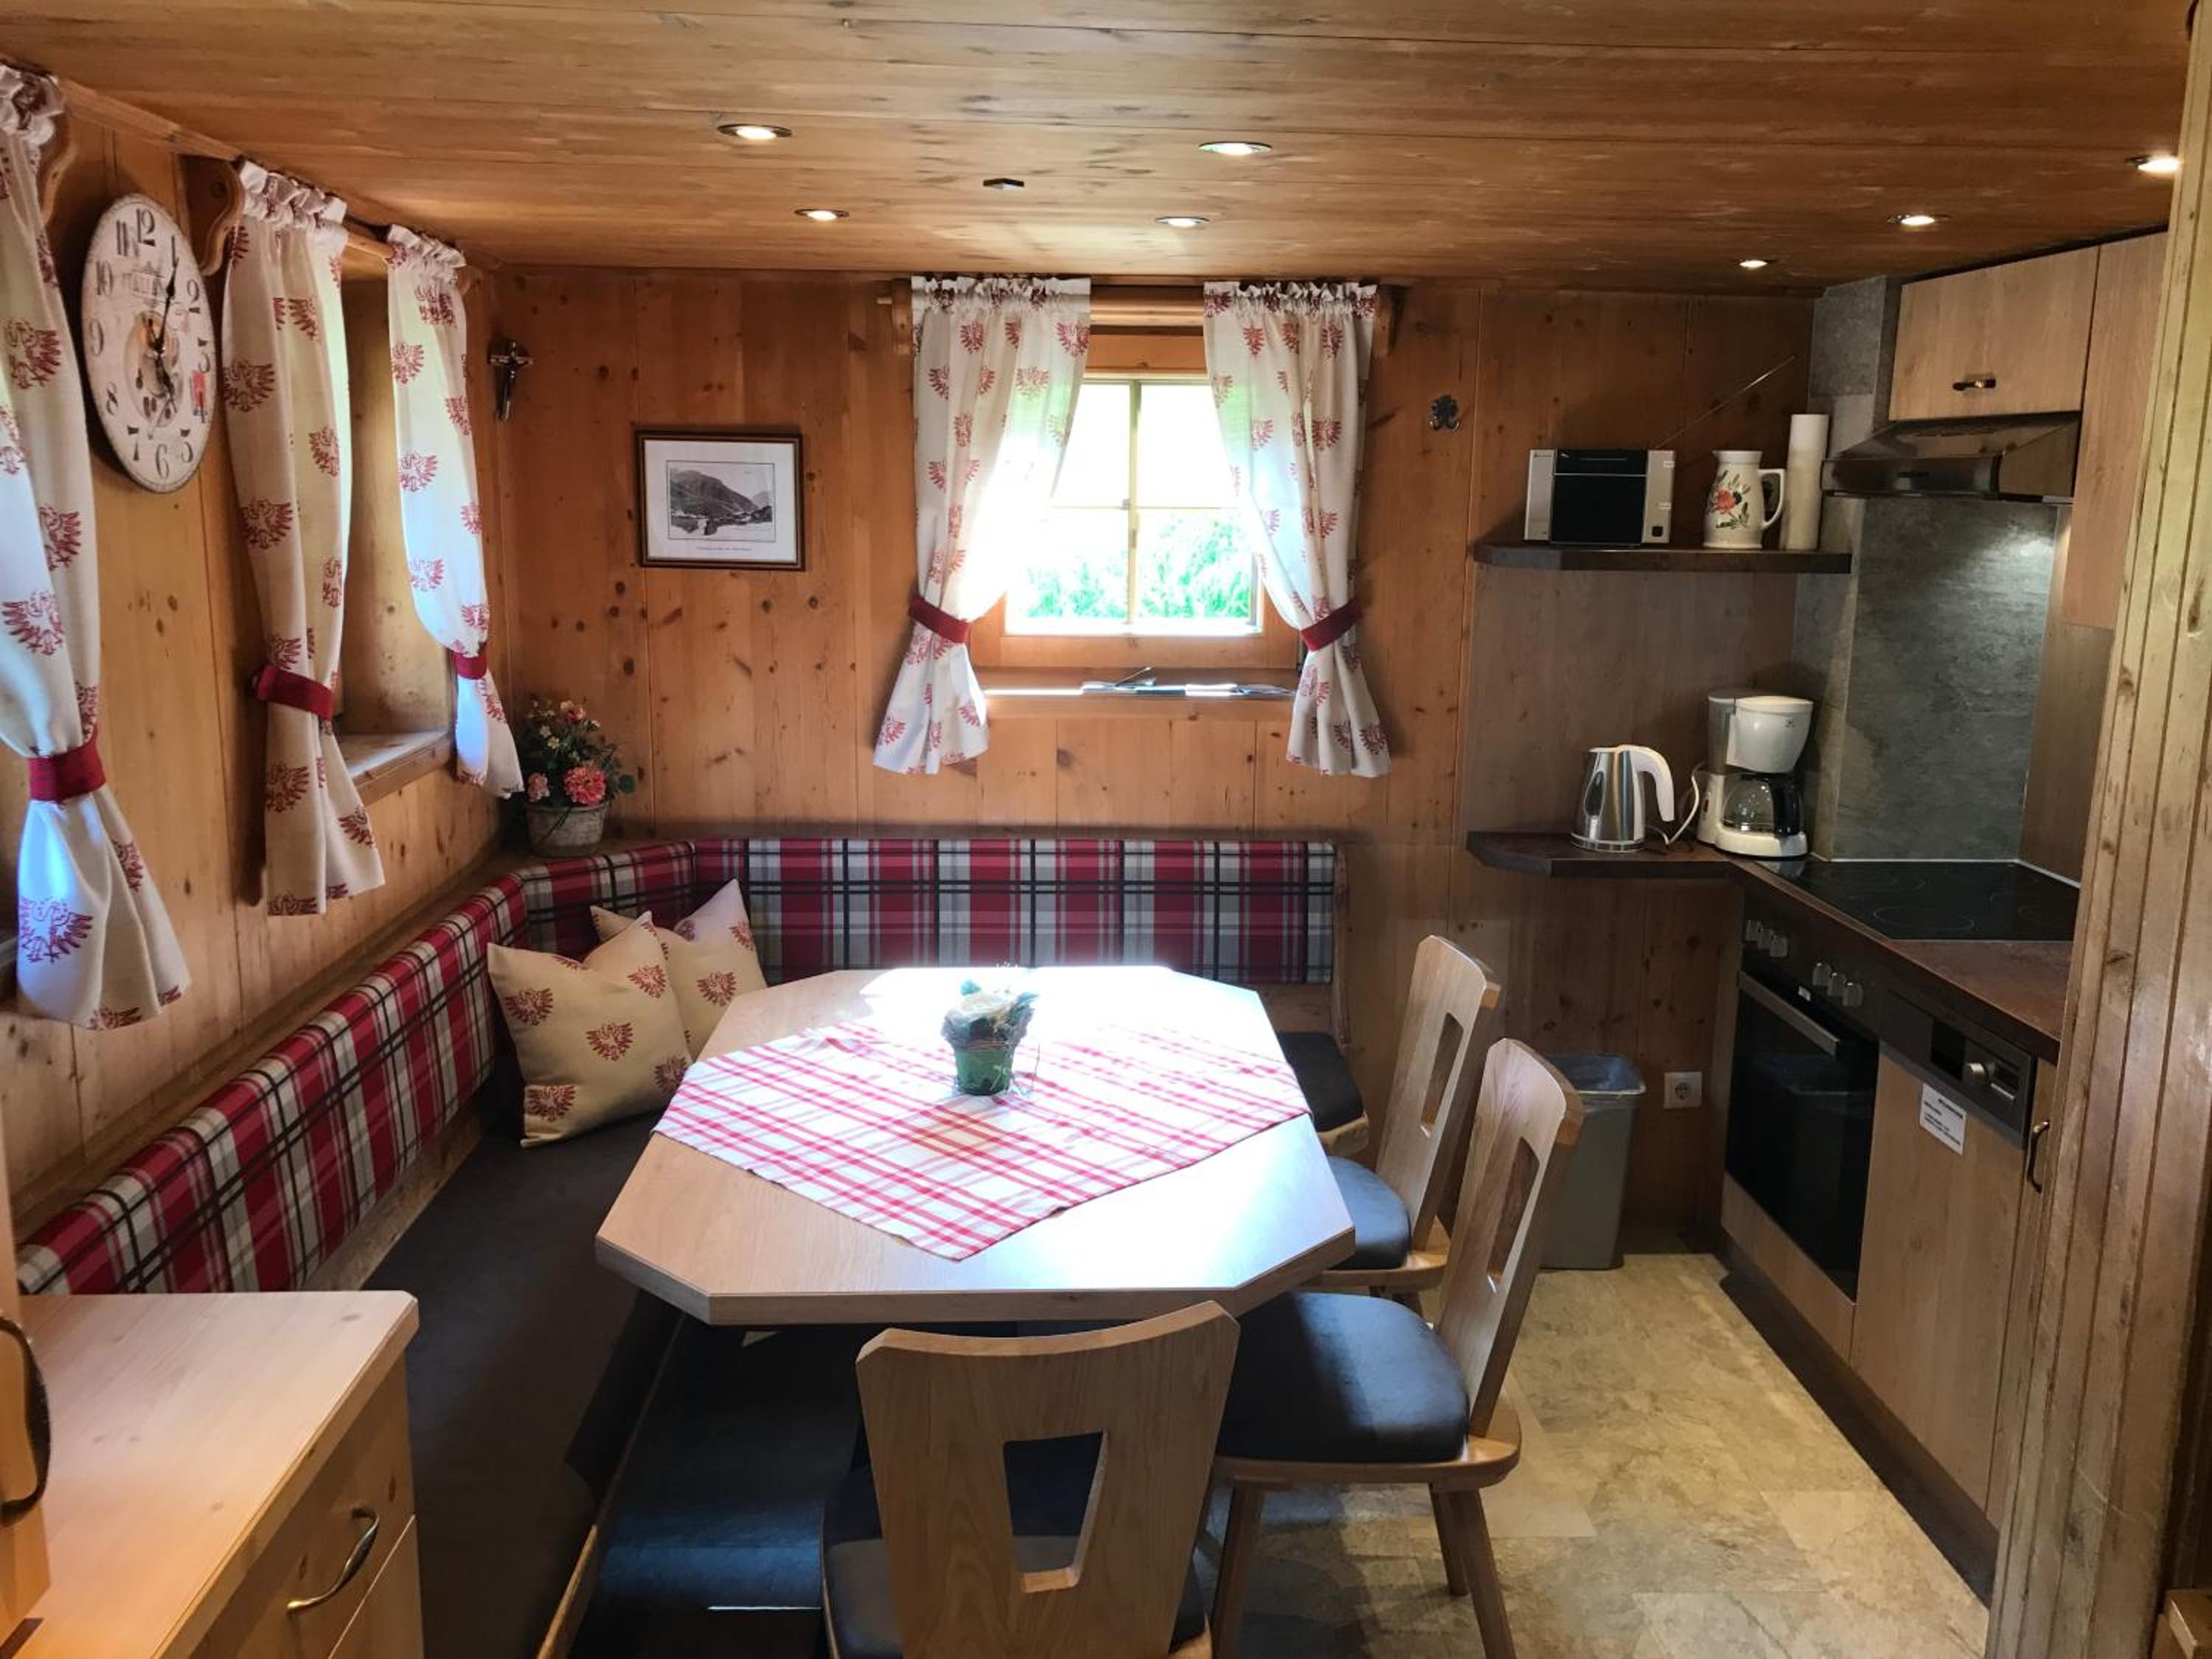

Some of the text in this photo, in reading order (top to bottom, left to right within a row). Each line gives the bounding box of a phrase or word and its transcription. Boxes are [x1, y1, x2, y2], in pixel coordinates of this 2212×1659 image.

[116, 220, 128, 257] 11
[136, 209, 156, 246] 12
[171, 236, 177, 268] 1
[96, 260, 113, 296] 10
[187, 279, 201, 314] 2
[89, 319, 105, 356] 9
[106, 382, 119, 416] 8
[127, 425, 139, 461] 7
[156, 443, 170, 479] 6
[180, 428, 193, 463] 5
